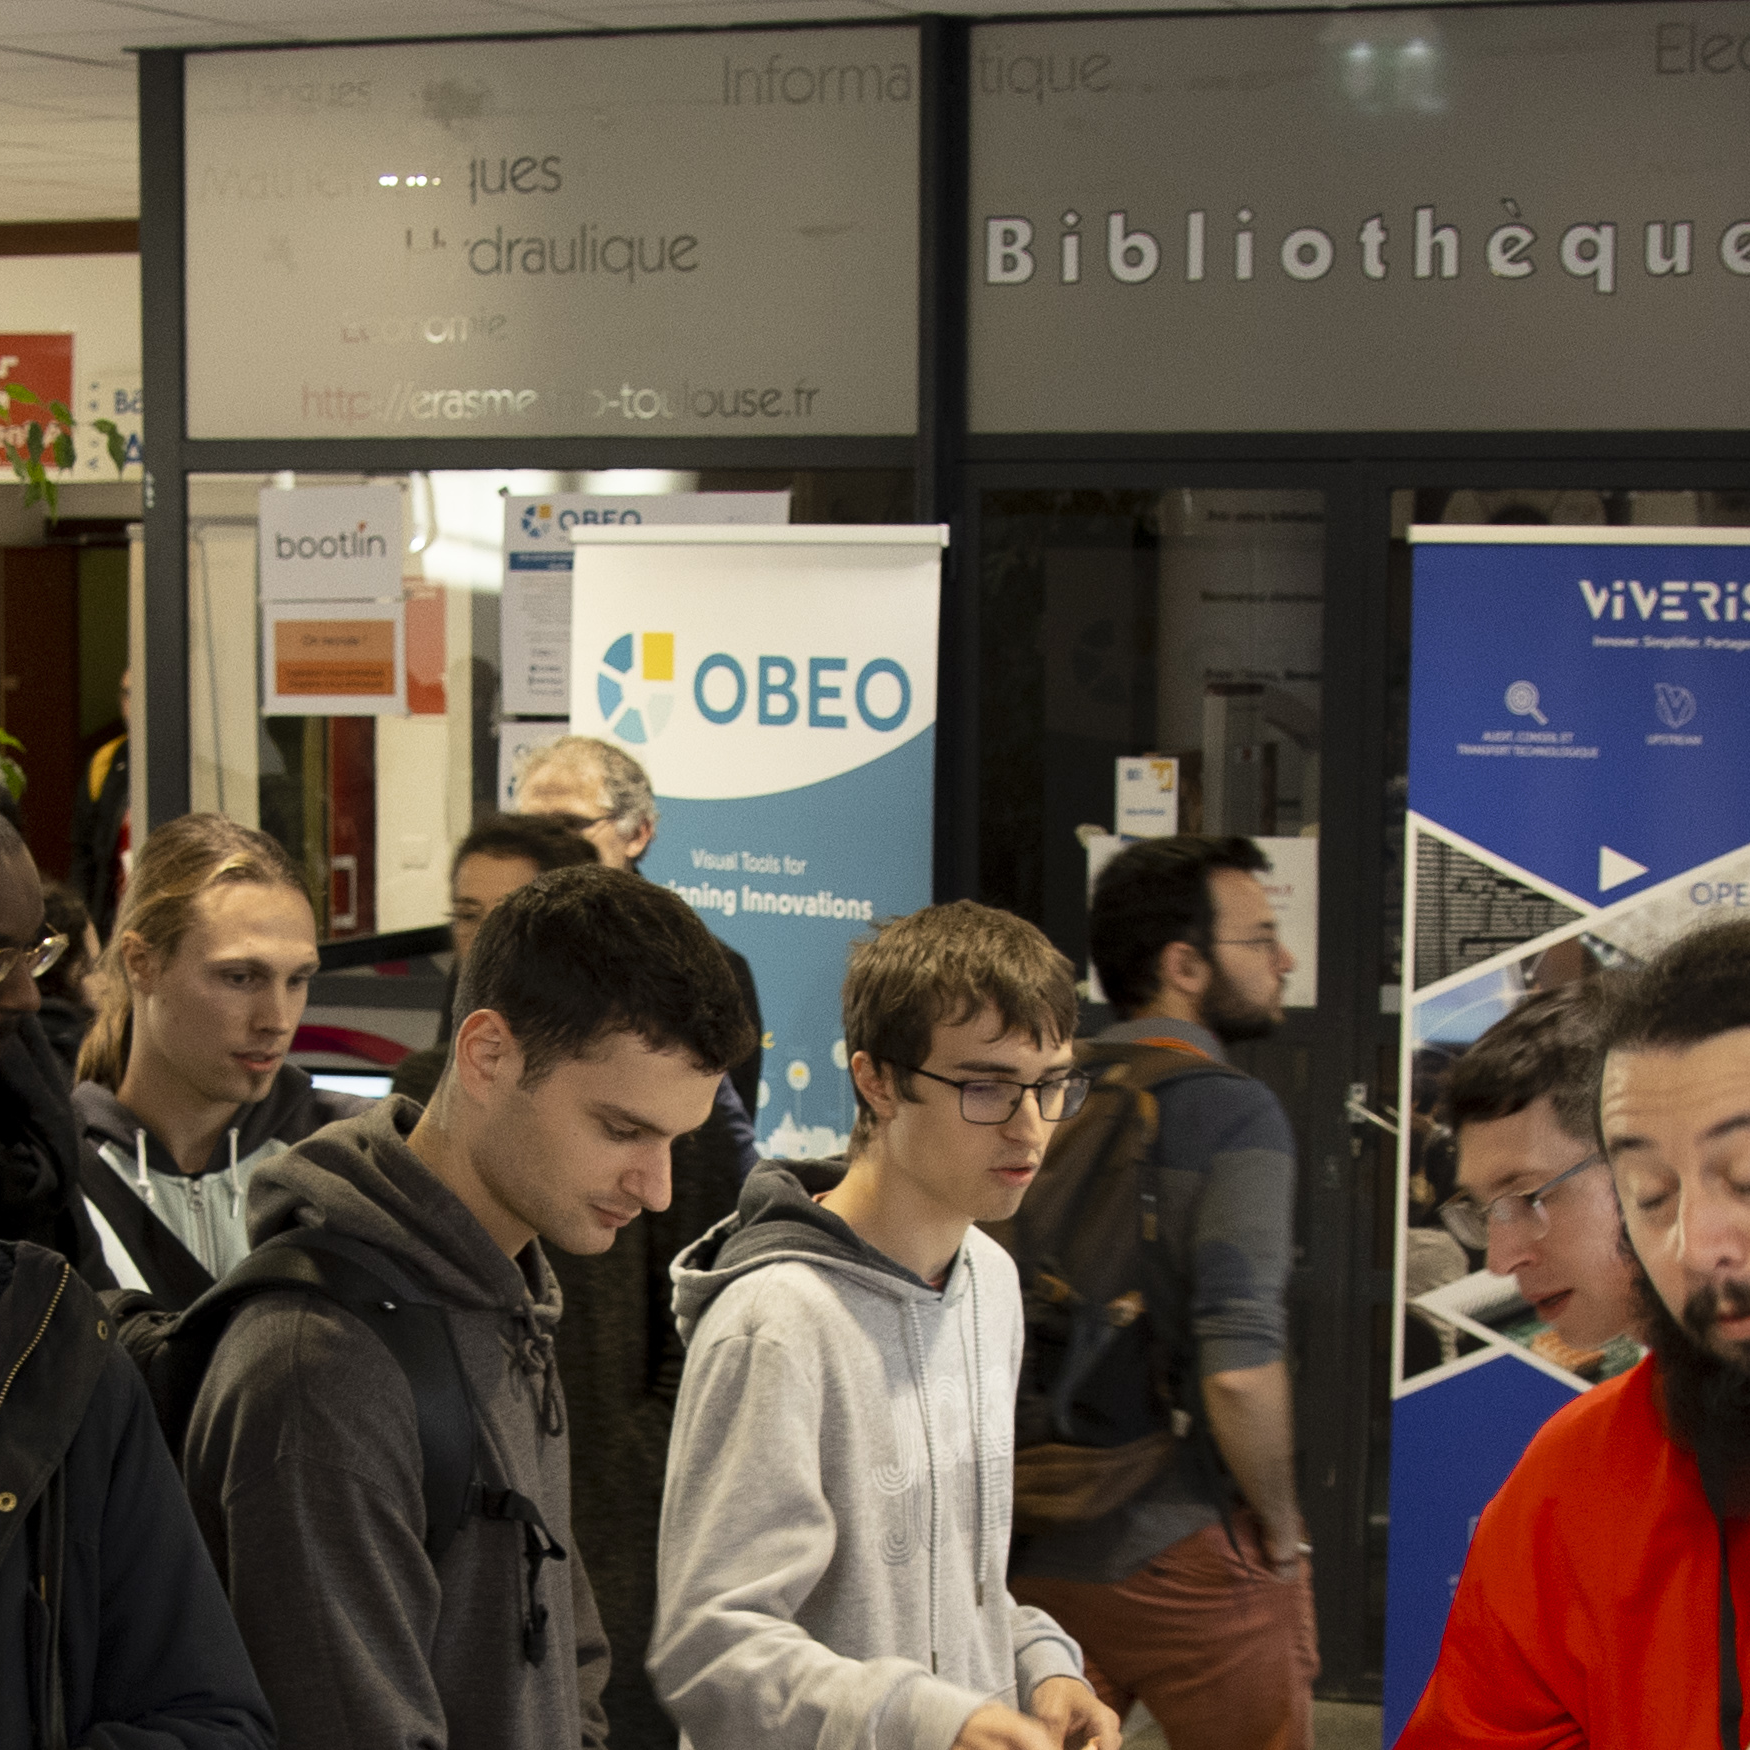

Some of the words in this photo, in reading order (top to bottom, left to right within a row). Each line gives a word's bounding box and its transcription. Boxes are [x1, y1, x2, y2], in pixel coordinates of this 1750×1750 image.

[275, 521, 387, 561] bootlin
[693, 651, 914, 734] OBEO
[690, 848, 739, 873] Visual
[742, 851, 780, 874] Tools
[783, 854, 809, 877] for
[742, 884, 875, 921] Innovations
